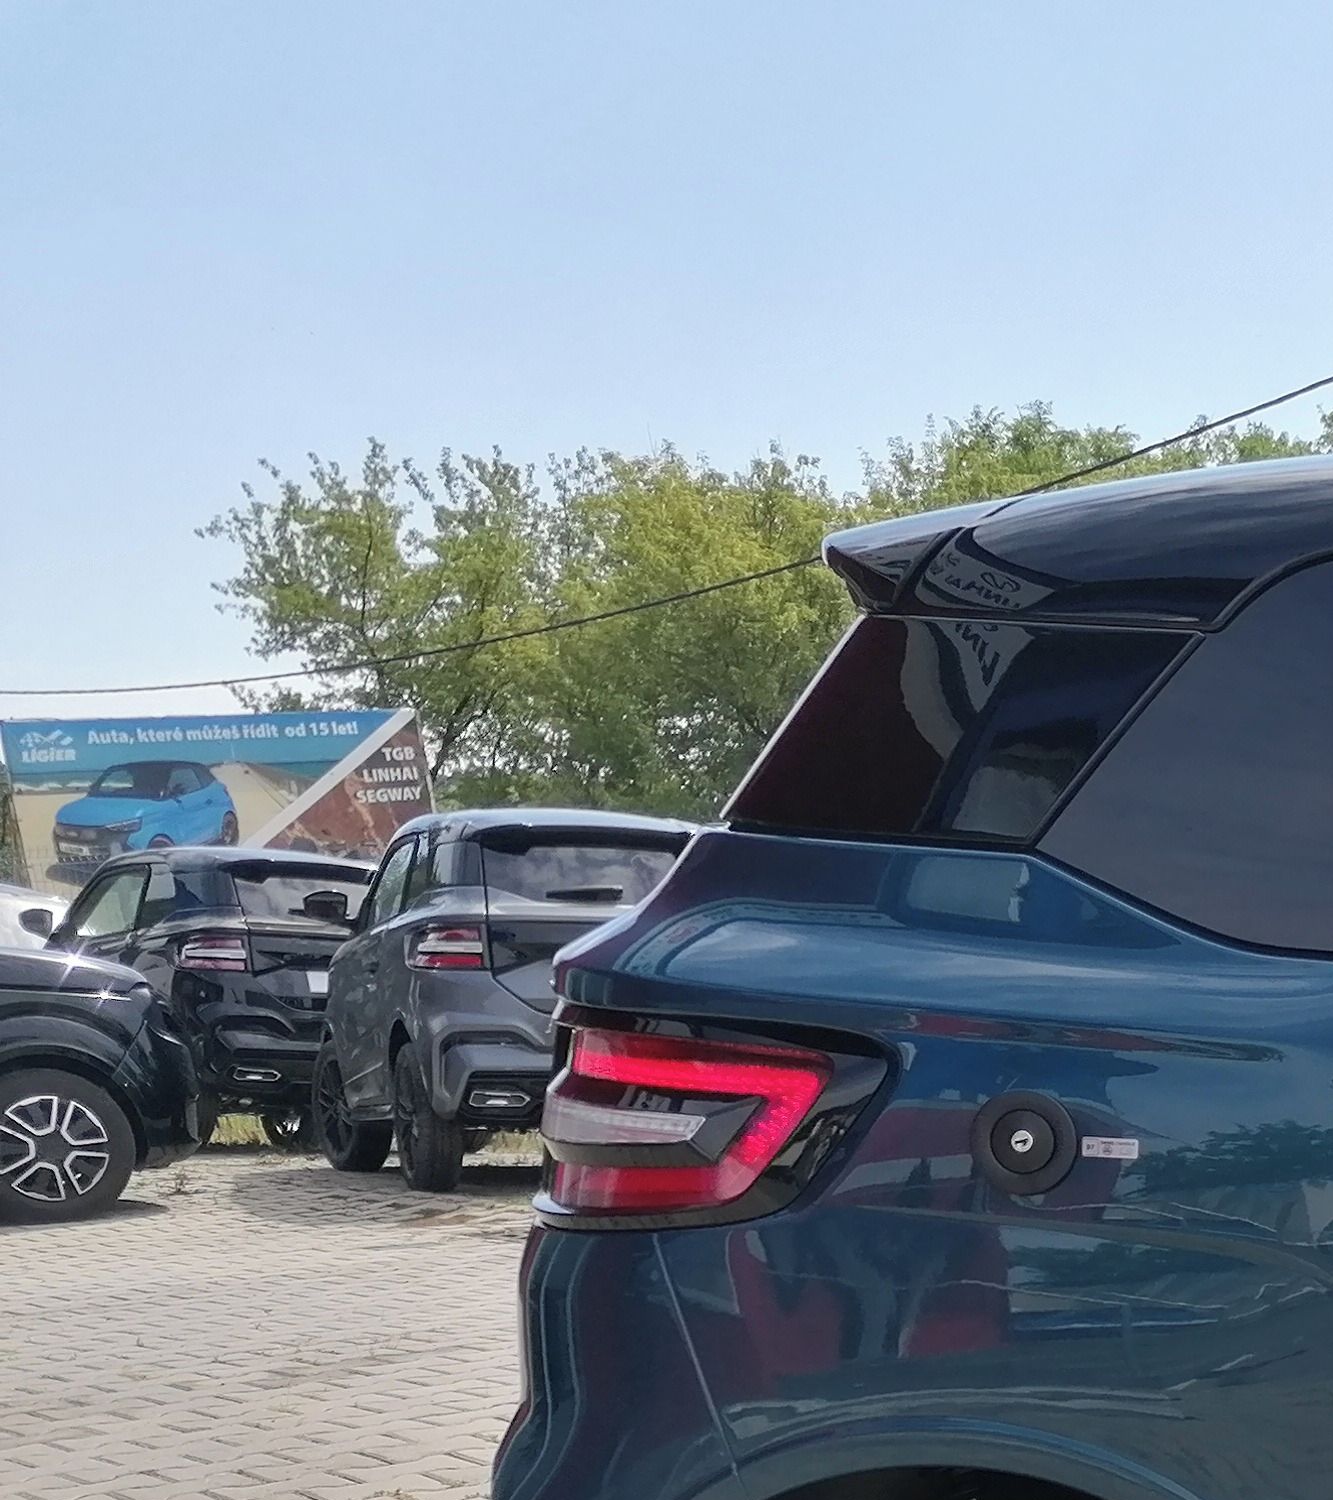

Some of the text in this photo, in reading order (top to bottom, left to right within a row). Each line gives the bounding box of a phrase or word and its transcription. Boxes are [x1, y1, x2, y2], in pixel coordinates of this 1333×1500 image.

[87, 729, 135, 745] Auta,
[136, 727, 183, 743] které
[186, 724, 241, 741] můžeš
[285, 723, 305, 738] od
[309, 722, 328, 736] 15
[381, 746, 416, 762] TGB
[363, 767, 418, 783] LINHAI
[356, 786, 422, 804] SEGWAY
